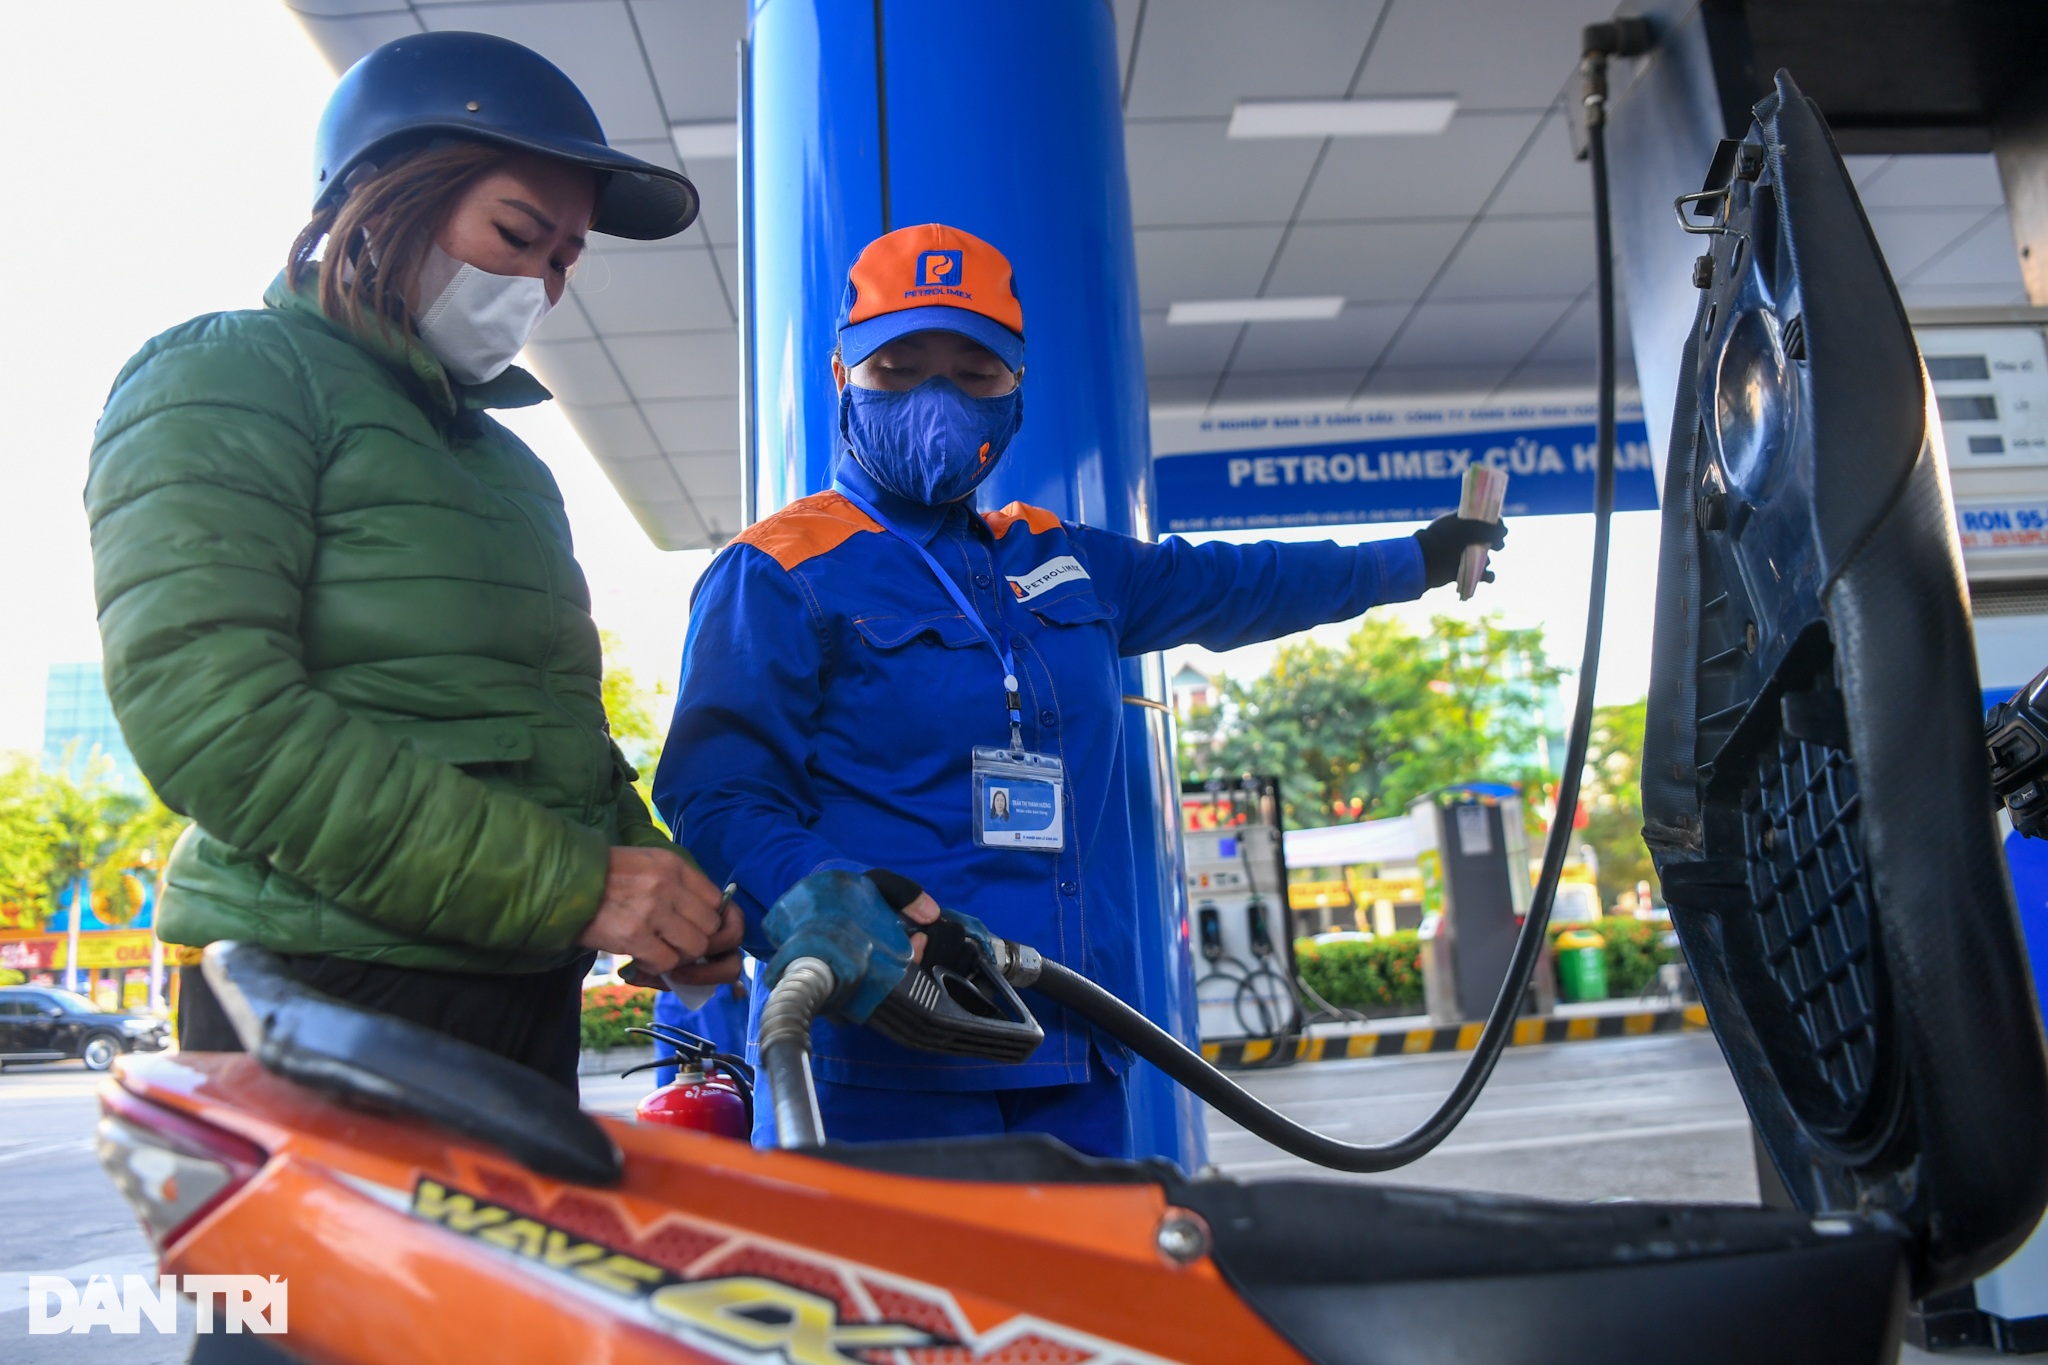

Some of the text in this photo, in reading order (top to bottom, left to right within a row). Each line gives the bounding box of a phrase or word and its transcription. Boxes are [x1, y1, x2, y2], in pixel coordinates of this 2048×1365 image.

[903, 288, 973, 301] PETROLIMEX
[1227, 449, 1472, 488] PETROLIMEX
[1963, 511, 2012, 531] RON
[1024, 565, 1082, 591] PETROLIMEX
[416, 1179, 665, 1294] WAVE
